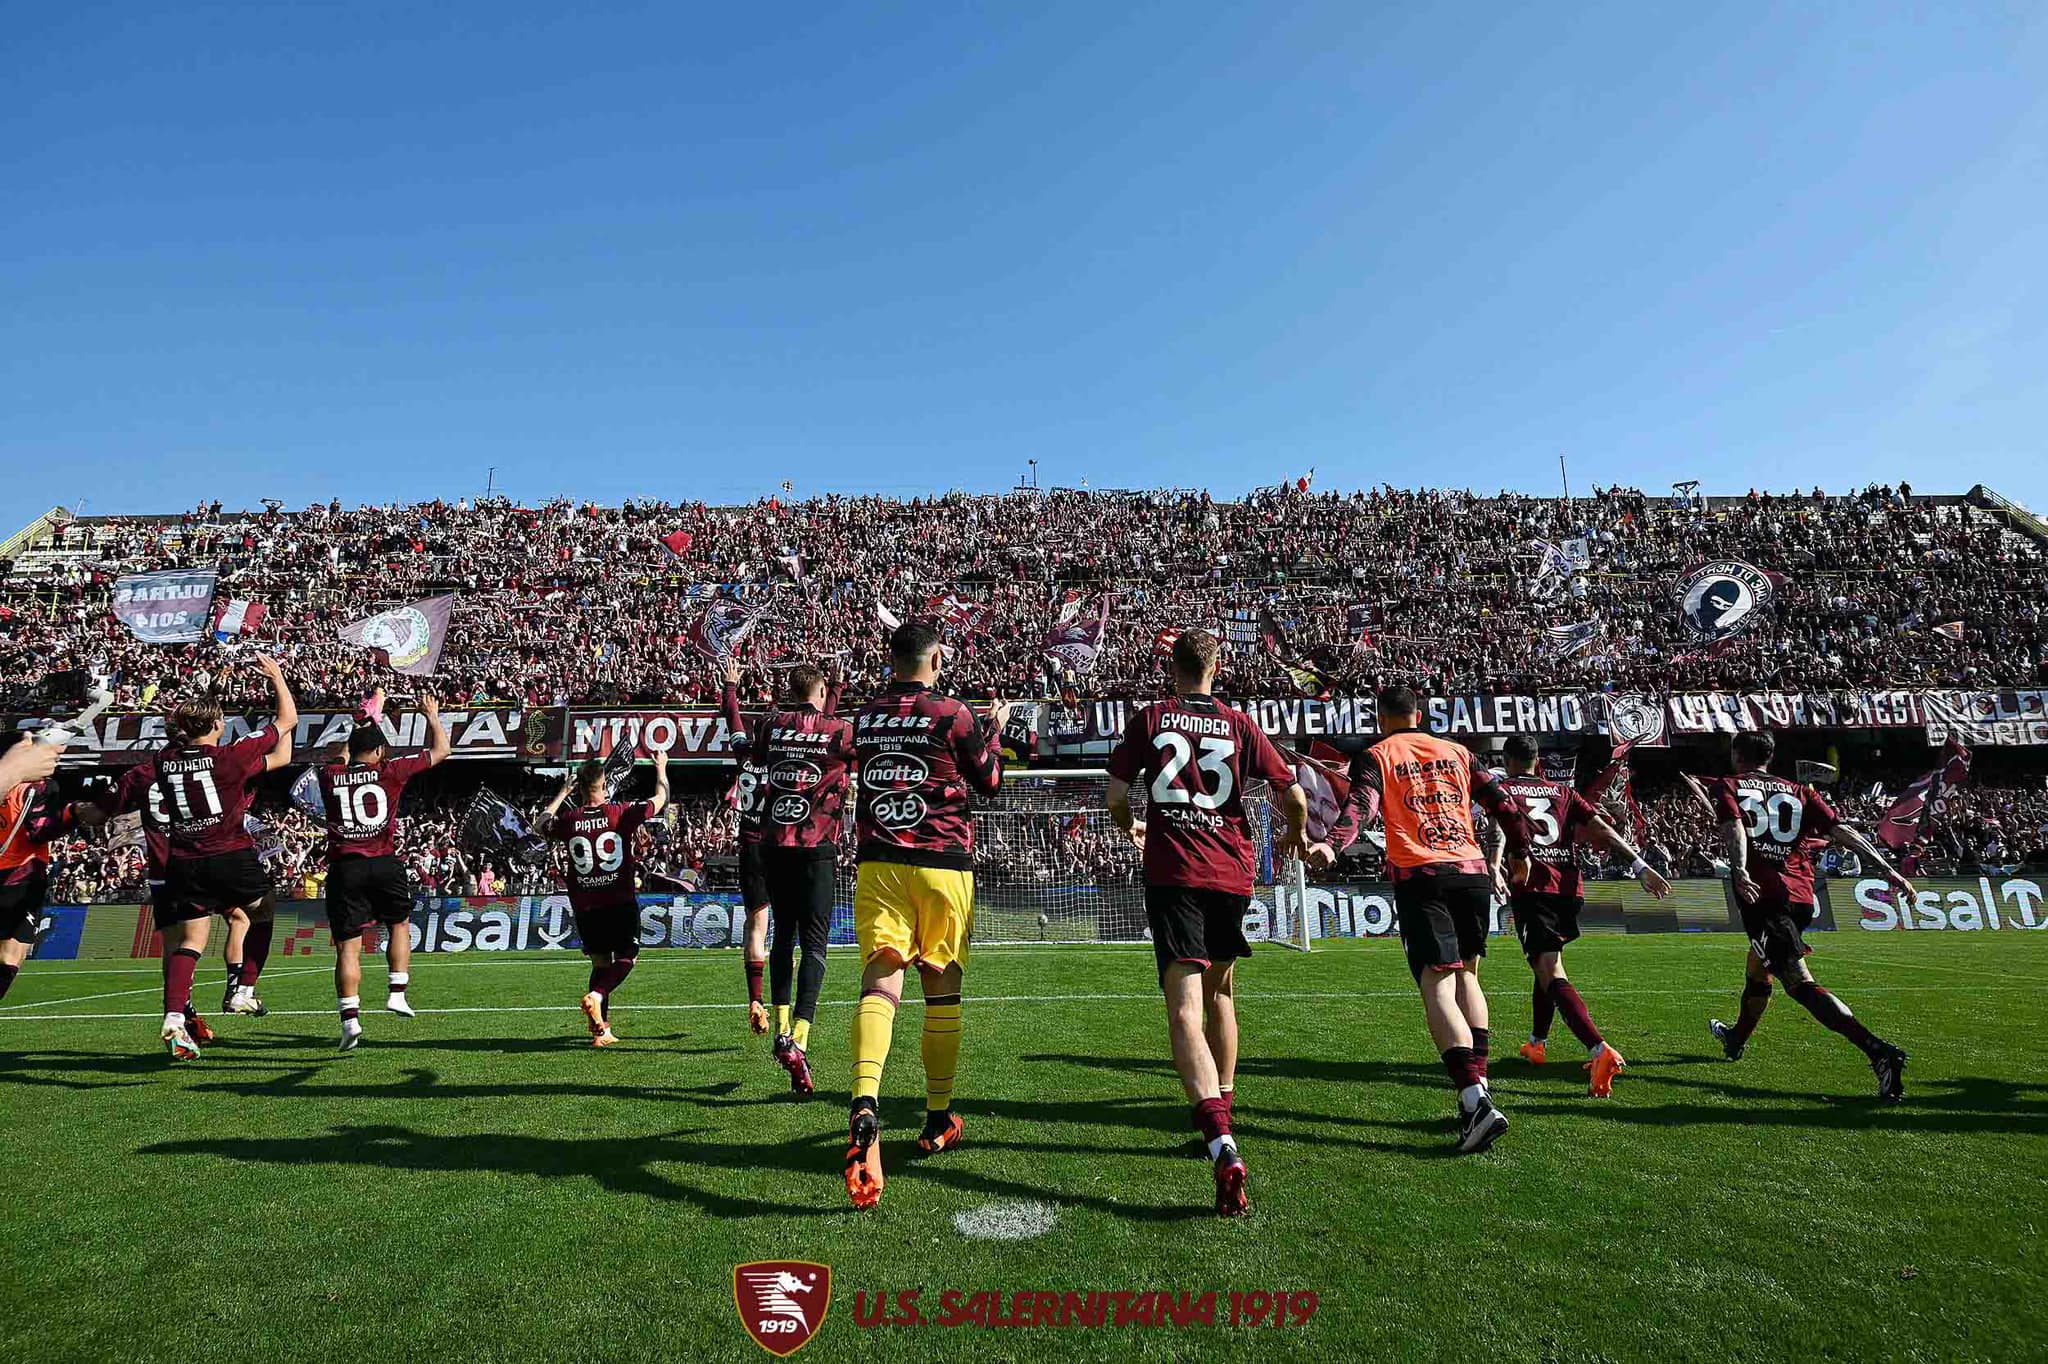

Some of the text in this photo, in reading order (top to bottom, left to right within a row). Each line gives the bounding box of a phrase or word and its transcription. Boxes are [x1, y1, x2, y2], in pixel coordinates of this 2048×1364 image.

[870, 713, 932, 729] Zeus
[1160, 712, 1231, 736] GYOMBER
[1429, 694, 1583, 734] SALERNO
[571, 717, 736, 754] NUOVA
[781, 729, 831, 743] Zeus
[856, 735, 929, 746] SALERNITANA
[768, 744, 828, 755] SALERNITANA
[879, 743, 902, 751] 1919
[162, 756, 215, 773] BOTHEIM
[867, 764, 924, 781] motta
[1151, 731, 1235, 810] 23
[333, 770, 379, 786] VILHENA
[772, 769, 819, 783] motta
[167, 769, 223, 820] 11
[332, 783, 388, 829] 10
[1737, 788, 1803, 843] 30
[1525, 797, 1560, 846] 3
[569, 831, 623, 874] 99
